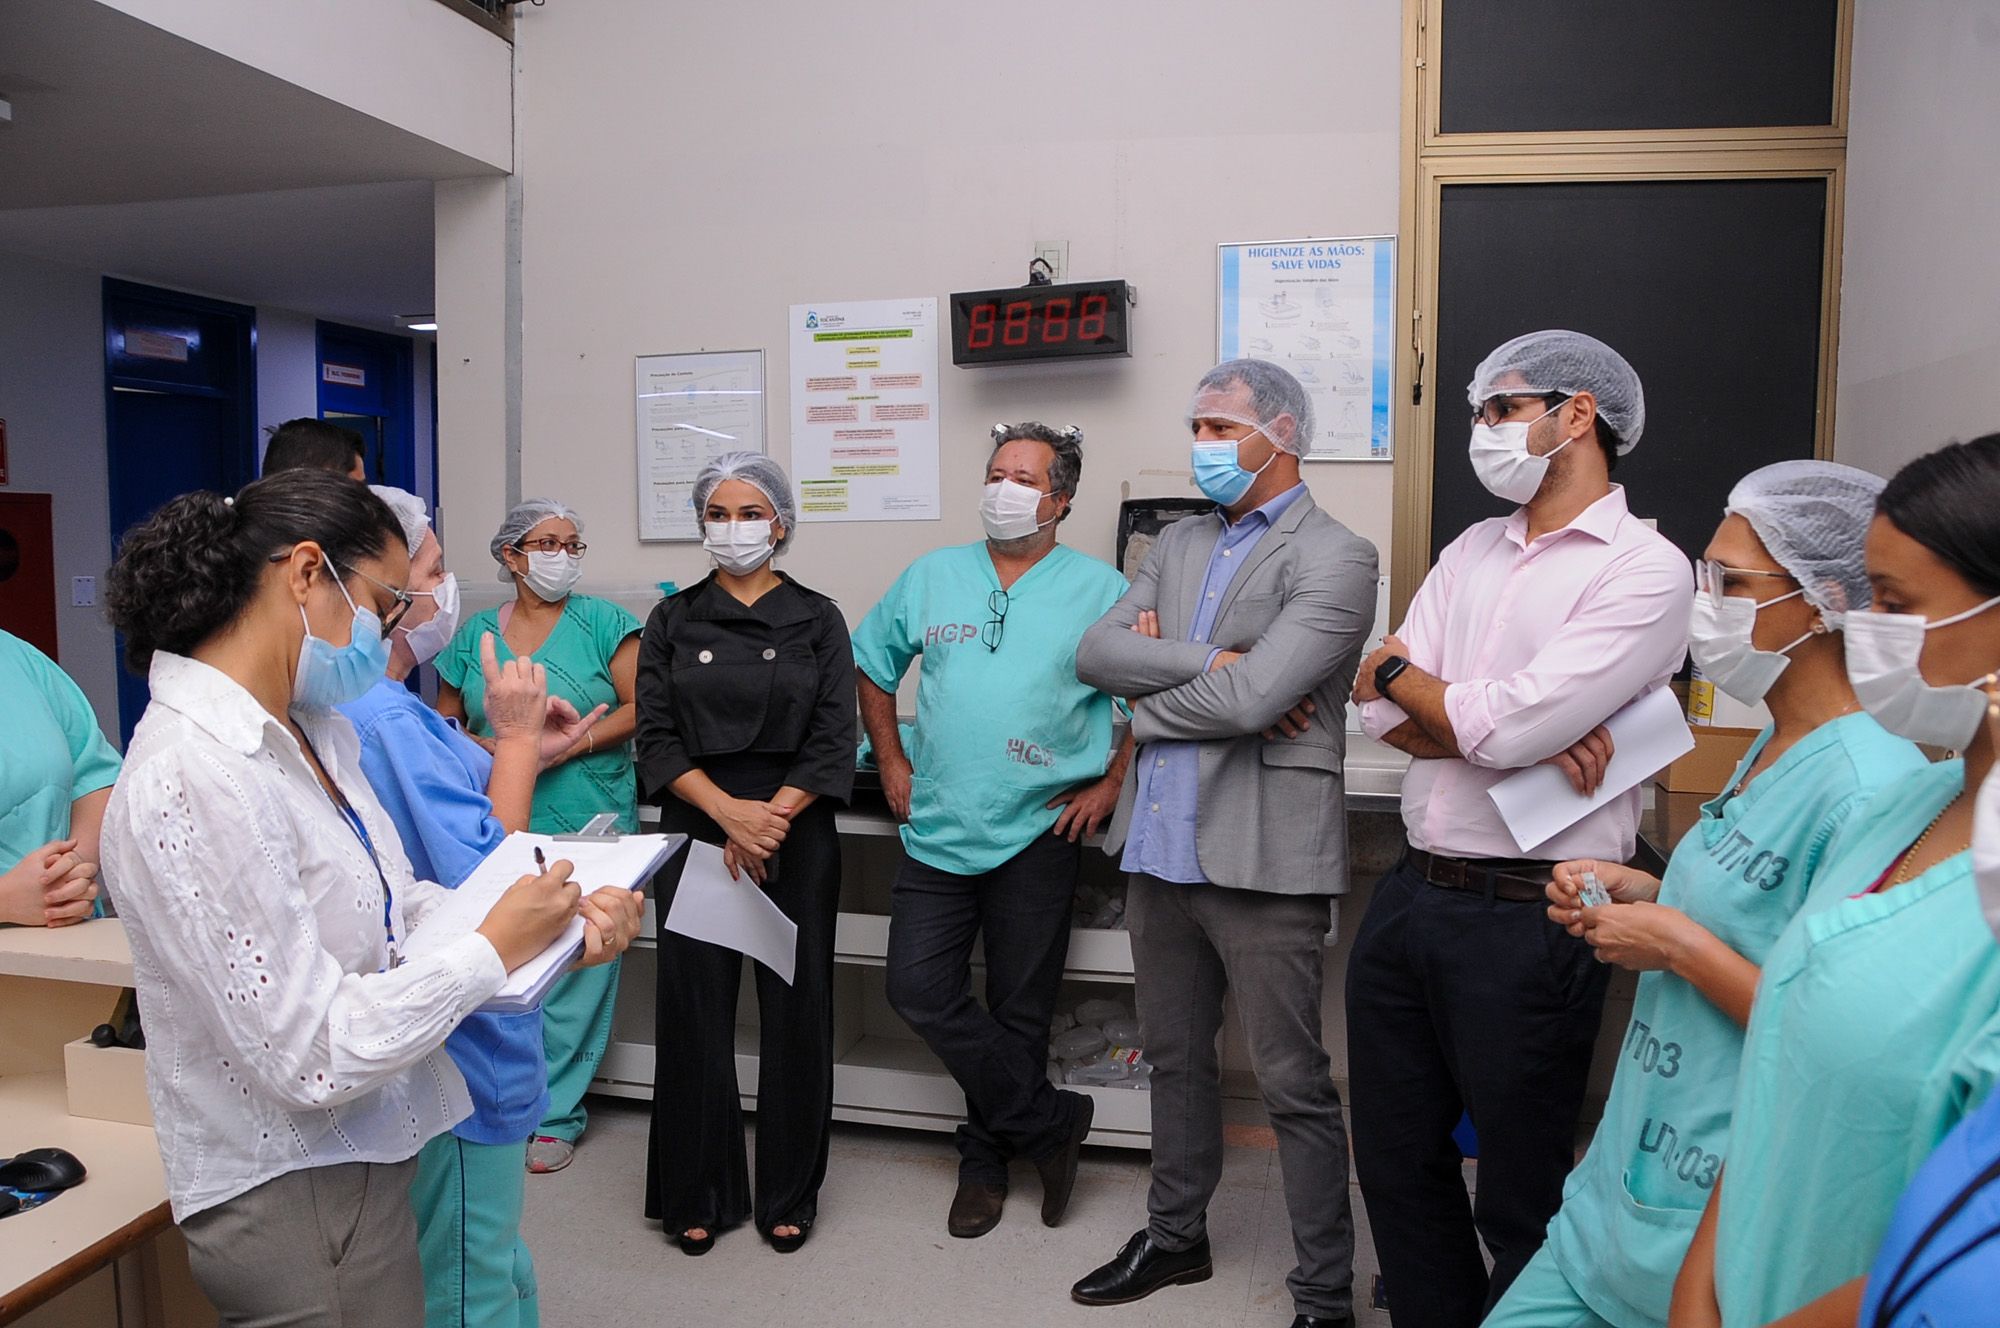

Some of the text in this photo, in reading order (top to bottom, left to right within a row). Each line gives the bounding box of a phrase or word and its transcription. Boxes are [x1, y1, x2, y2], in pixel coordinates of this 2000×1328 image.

[1248, 244, 1365, 258] HIGIENIZE AS MÃOS:
[1271, 258, 1341, 271] SALVE VIDAS
[925, 623, 978, 647] HGP
